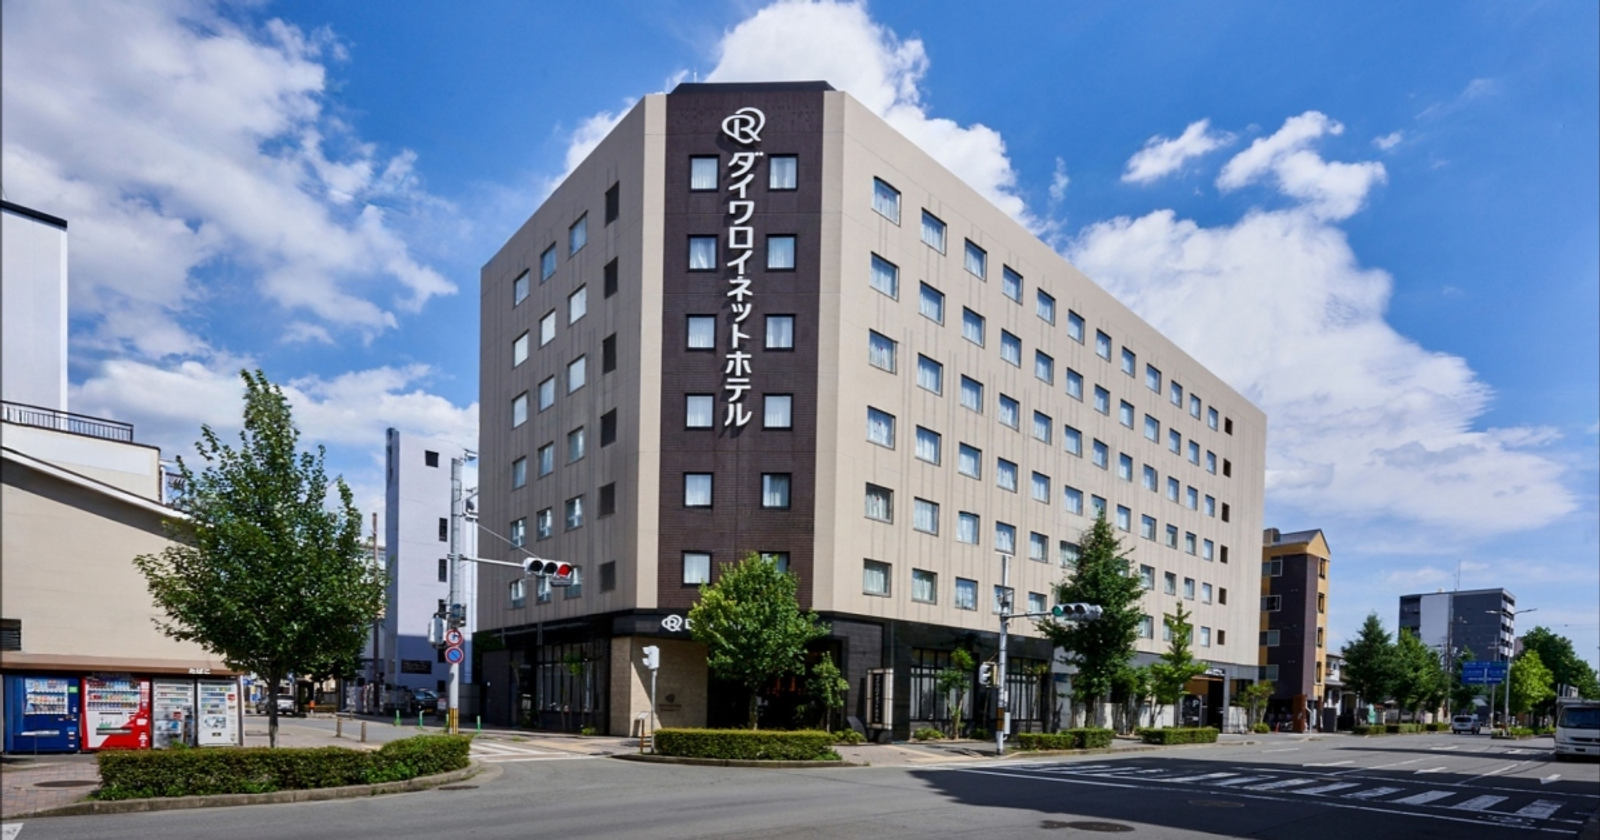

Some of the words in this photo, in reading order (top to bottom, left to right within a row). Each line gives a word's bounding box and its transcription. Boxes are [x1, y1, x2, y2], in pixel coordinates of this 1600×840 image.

[724, 152, 764, 427] ダイワロイネットホテル
[1192, 699, 1199, 708] P
